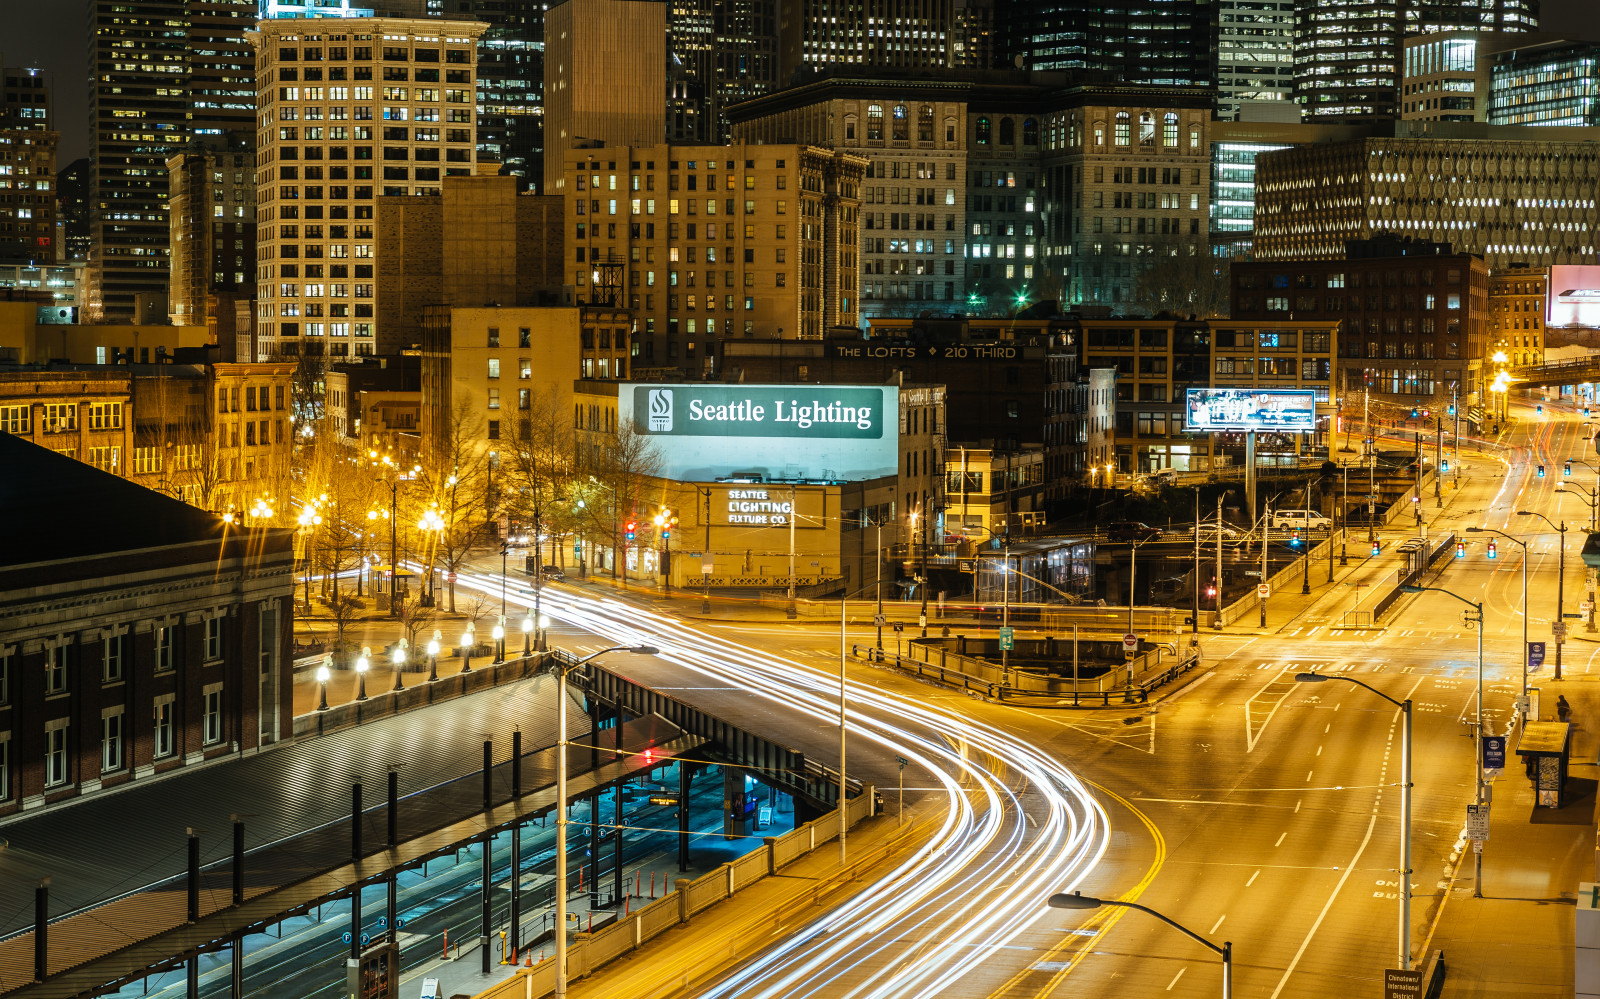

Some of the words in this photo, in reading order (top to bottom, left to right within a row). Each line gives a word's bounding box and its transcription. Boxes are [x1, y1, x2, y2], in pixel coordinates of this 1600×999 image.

[837, 346, 861, 356] THE
[867, 347, 916, 358] LOFTS
[944, 348, 968, 358] 210
[973, 348, 1016, 358] THIRD
[688, 400, 765, 422] Seattle
[774, 400, 872, 430] Lighting
[728, 490, 768, 500] SEATTLE
[728, 502, 792, 513] LIGHTING
[728, 515, 768, 524] FIXTURE
[770, 515, 787, 524] CO.
[1376, 880, 1419, 889] ONY
[1372, 891, 1401, 899] BU
[1388, 974, 1419, 983] Chinatown/
[1388, 983, 1420, 992] International
